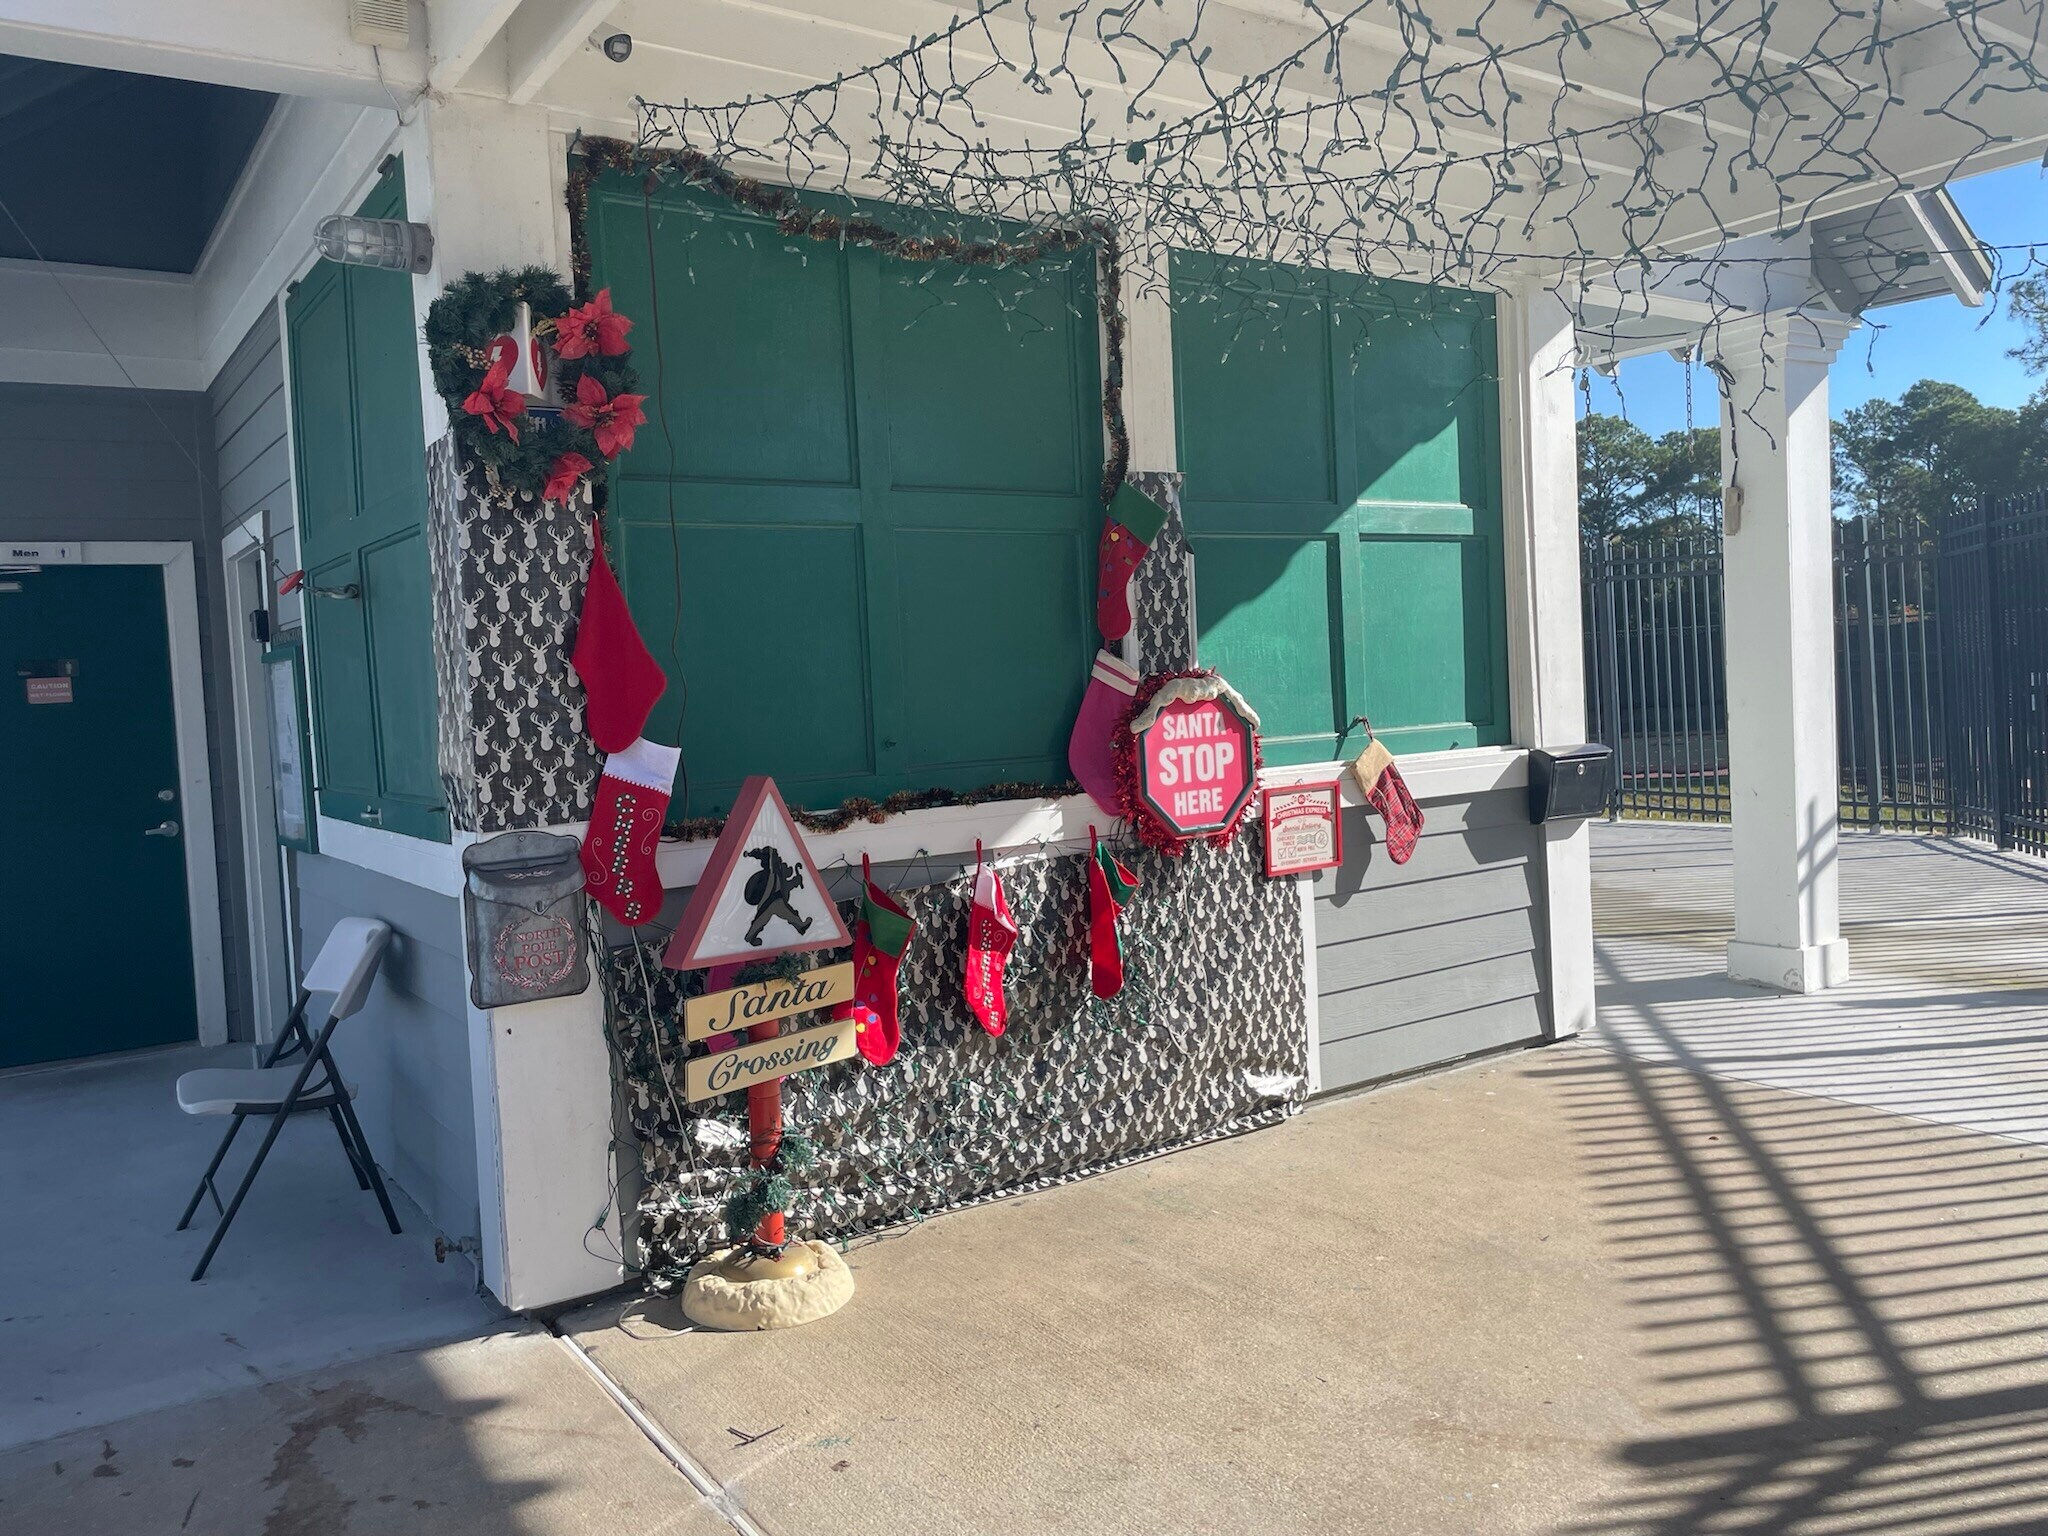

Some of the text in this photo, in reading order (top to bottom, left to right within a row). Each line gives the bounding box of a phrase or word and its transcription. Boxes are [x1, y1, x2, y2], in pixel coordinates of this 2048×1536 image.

[12, 549, 39, 558] Men
[31, 682, 69, 690] CAUTION
[1163, 712, 1227, 741] SANTA
[1159, 742, 1235, 786] STOP
[1174, 787, 1224, 817] HERE
[1277, 808, 1305, 818] CHRISTMAS
[516, 927, 561, 942] NORTH
[522, 940, 557, 953] POLE
[514, 951, 563, 971] POST
[708, 979, 836, 1031] Santa
[708, 1034, 838, 1091] Crossing
